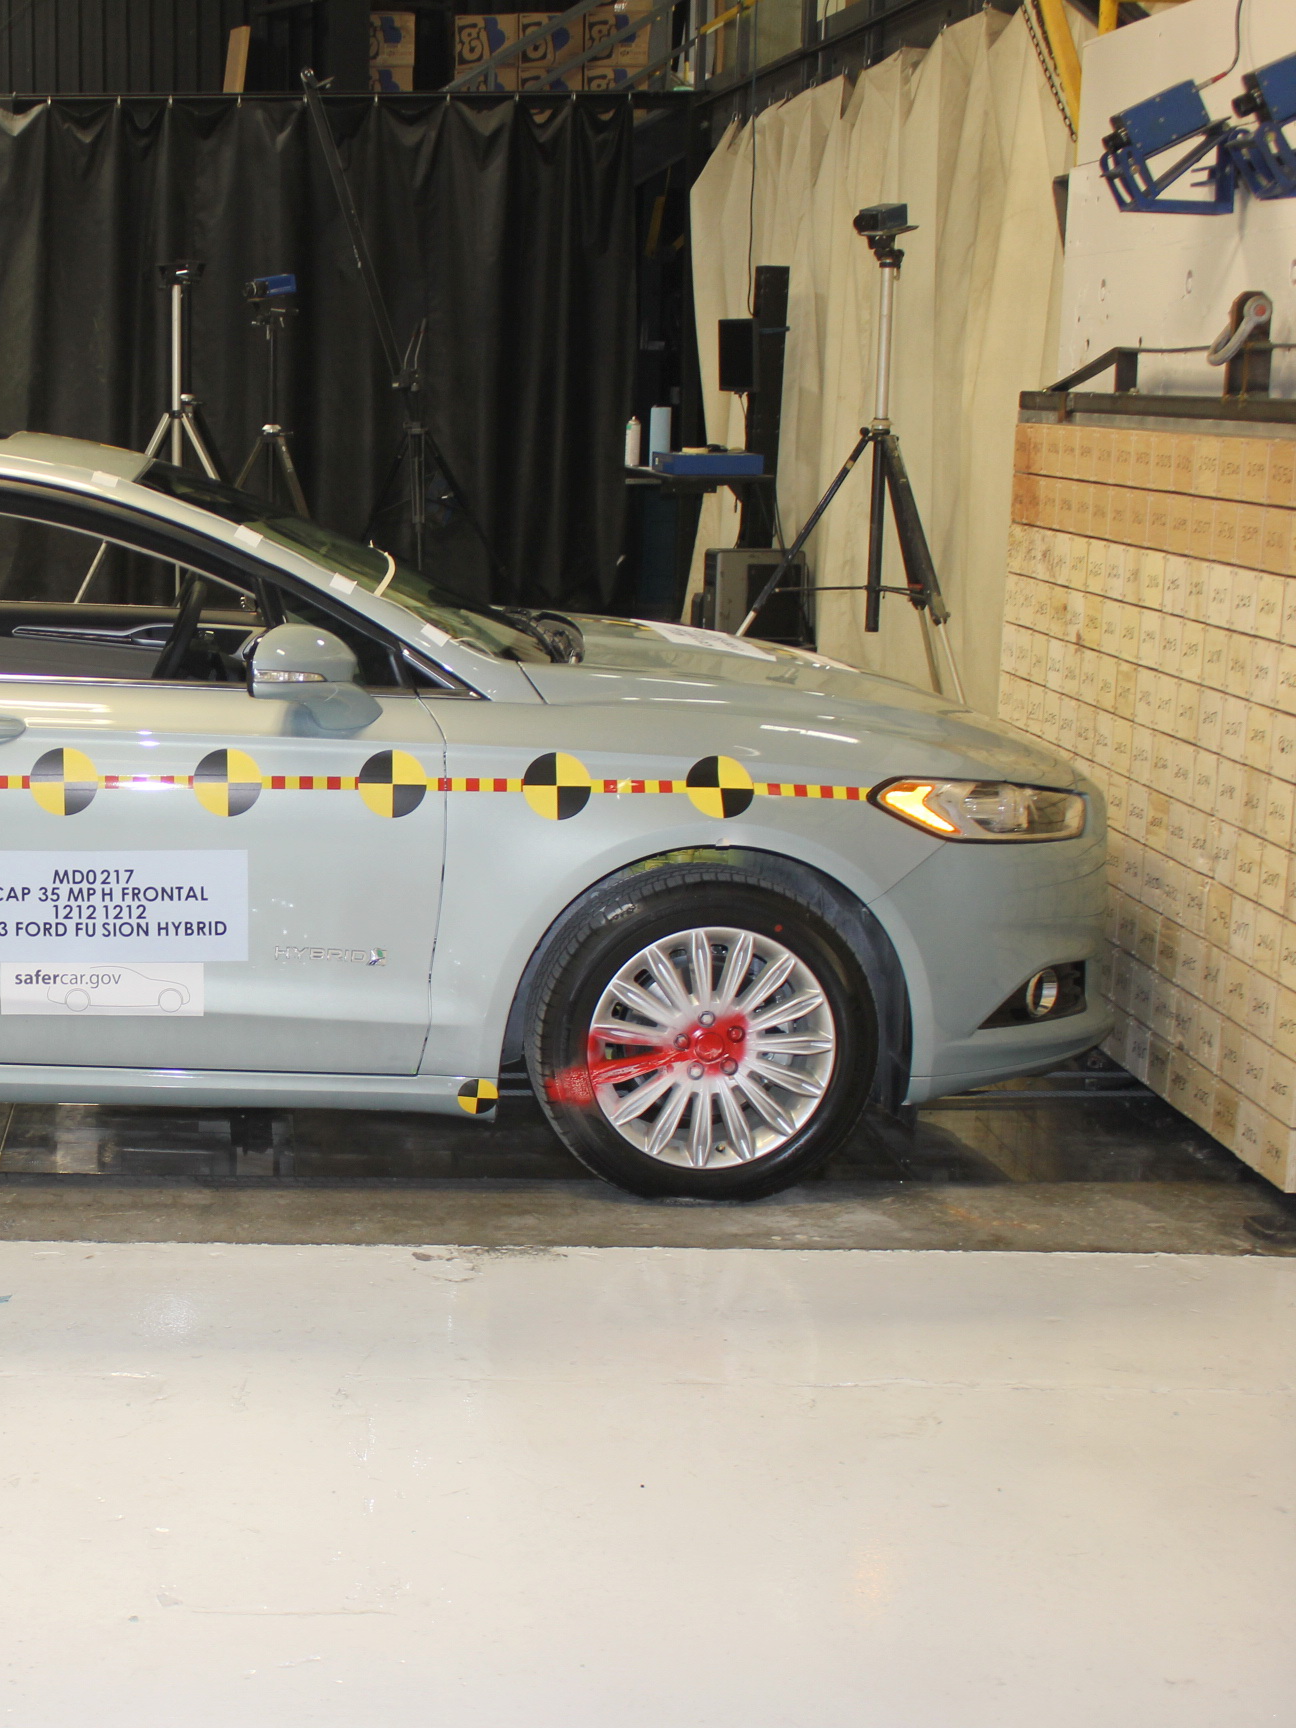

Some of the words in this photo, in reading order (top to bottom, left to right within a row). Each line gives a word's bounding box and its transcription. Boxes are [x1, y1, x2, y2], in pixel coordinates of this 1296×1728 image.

[52, 869, 135, 885] MD0217
[37, 887, 61, 902] 35
[121, 886, 208, 902] FRONTAL
[15, 921, 68, 938] FORD
[157, 920, 228, 937] HYBRID
[274, 945, 367, 962] HYBRID
[14, 969, 122, 989] safercar.gov
